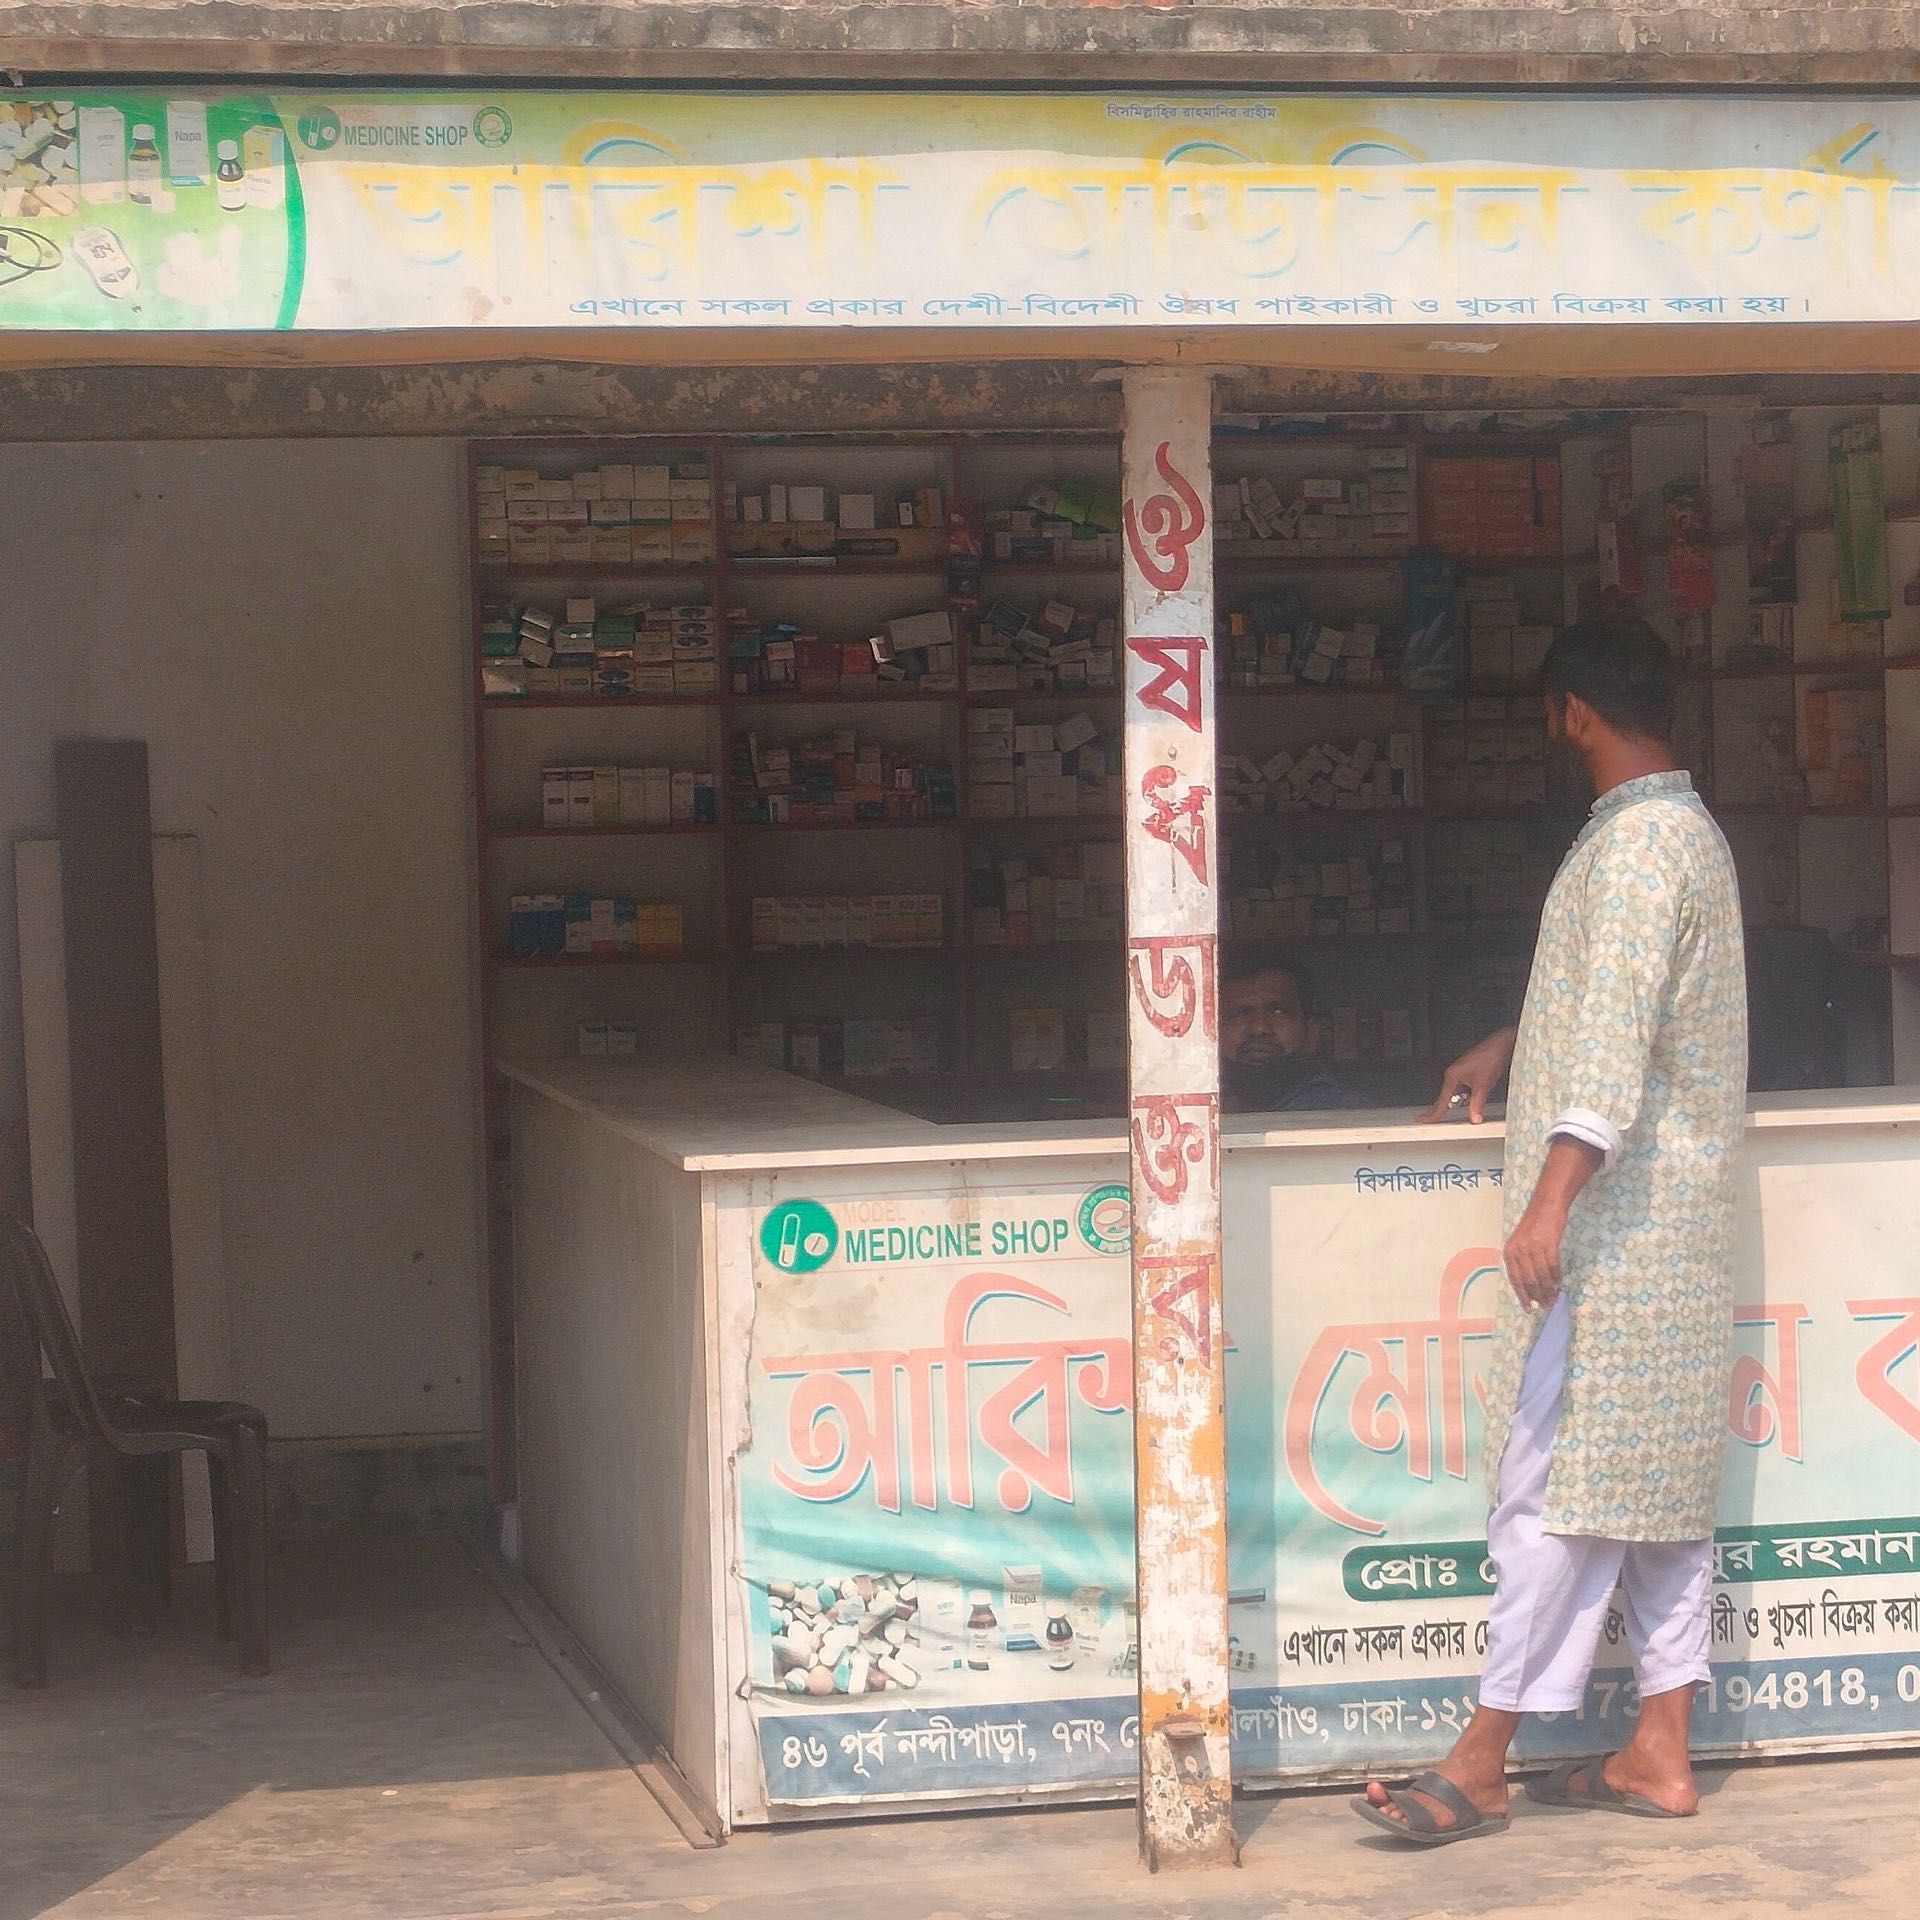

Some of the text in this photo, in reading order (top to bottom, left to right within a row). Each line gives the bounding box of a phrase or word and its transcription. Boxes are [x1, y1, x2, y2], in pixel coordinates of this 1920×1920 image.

[174, 131, 201, 142] Napa
[344, 126, 420, 146] MEDICINE
[425, 126, 468, 146] SHOP
[570, 296, 684, 317] এখানে
[700, 297, 790, 317] সকল
[806, 297, 906, 317] প্রকার
[922, 293, 1142, 317] দেশী-বিদেশী
[1254, 293, 1397, 317] পাইকারী
[1411, 297, 1440, 314] ও
[1458, 296, 1536, 318] খুচরা
[1552, 293, 1648, 317] বিক্রয়
[1662, 295, 1728, 316] করা
[1742, 296, 1789, 316] হয়
[1354, 1164, 1481, 1193] বিসমিল্লাহির
[844, 1201, 907, 1224] MODEL
[845, 1222, 983, 1264] MEDICINE
[990, 1218, 1069, 1256] SHOP
[1770, 1528, 1919, 1572] রহমান
[1009, 1593, 1036, 1606] Napa
[1283, 1624, 1349, 1667] এখানে
[1353, 1624, 1405, 1661] সকল
[1411, 1617, 1468, 1662] প্রকার
[1743, 1606, 1759, 1639] ও
[1768, 1599, 1815, 1650] খুচরা
[1820, 1588, 1878, 1639] বিক্রয়
[1881, 1592, 1920, 1634] করা
[782, 1735, 828, 1769] ৪৬
[840, 1717, 889, 1778] পূর্ব
[893, 1715, 1036, 1764] নন্দীপাড়া,
[1051, 1718, 1112, 1754] ৭নং
